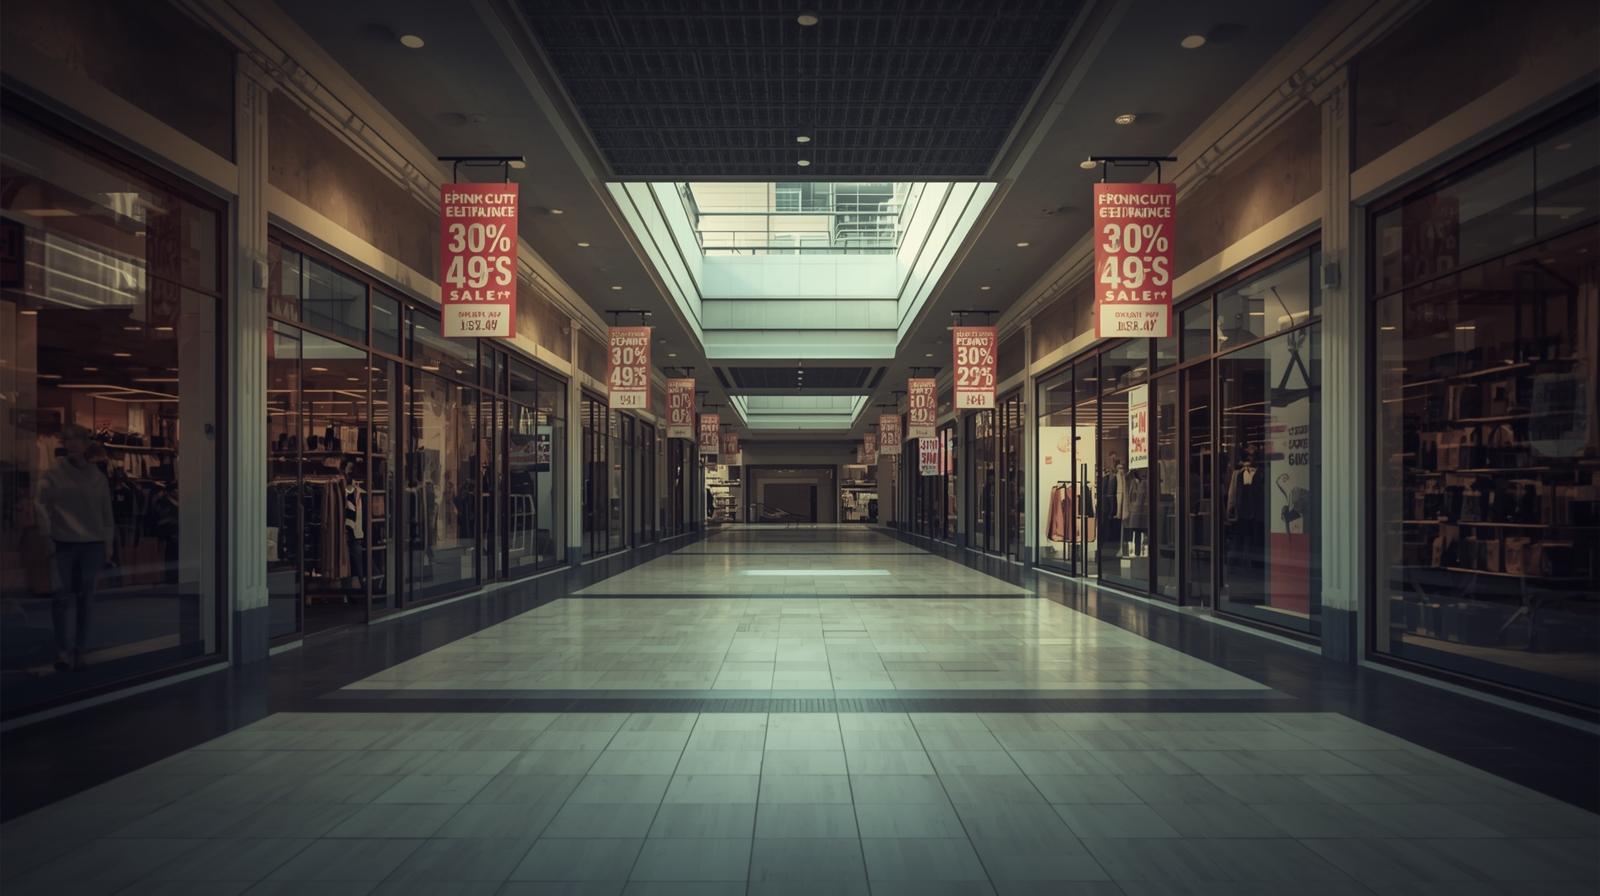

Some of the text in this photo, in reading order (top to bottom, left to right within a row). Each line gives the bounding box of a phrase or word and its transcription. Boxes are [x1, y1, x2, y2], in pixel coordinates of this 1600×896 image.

[448, 223, 511, 253] 30%
[1102, 223, 1169, 254] 30%
[611, 346, 647, 365] 30%
[957, 345, 993, 366] 30%
